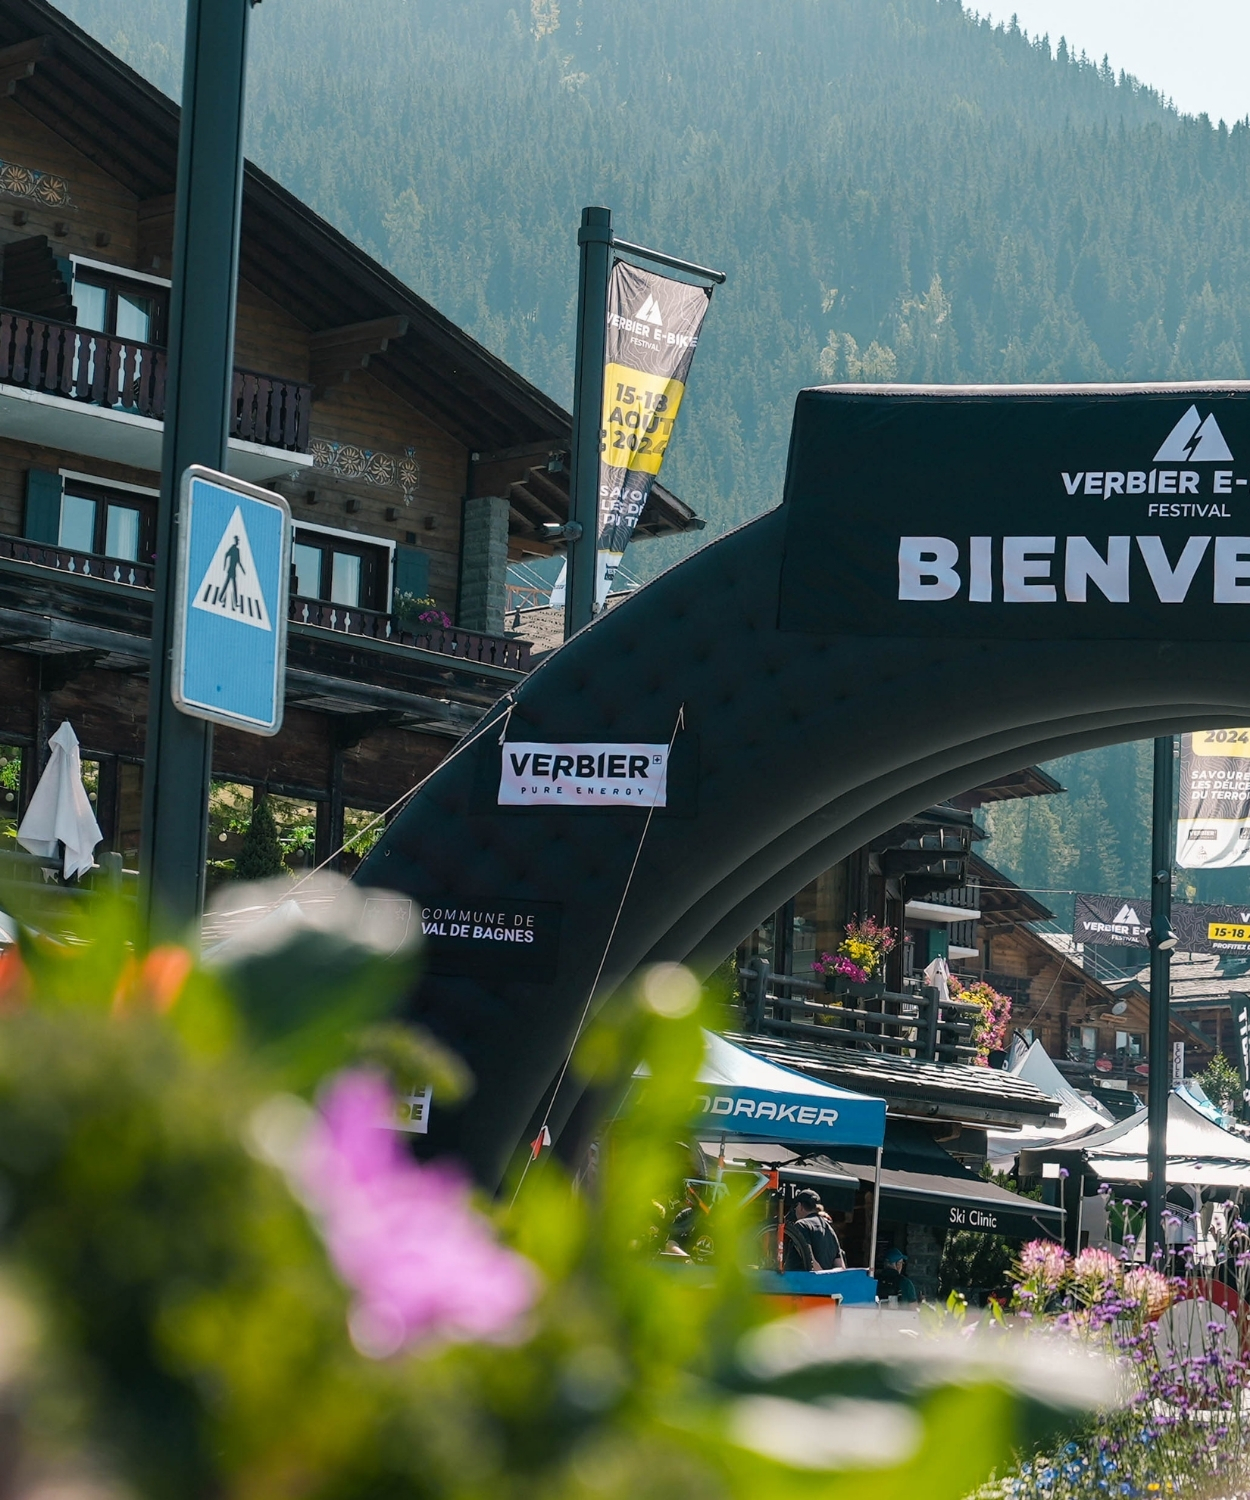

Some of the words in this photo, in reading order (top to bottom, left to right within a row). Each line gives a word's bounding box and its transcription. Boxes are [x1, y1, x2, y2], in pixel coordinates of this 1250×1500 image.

[630, 337, 660, 351] FESTIVAL
[654, 328, 699, 349] E-BIKE
[616, 383, 668, 413] 15-18
[608, 406, 675, 436] AOÛT
[613, 430, 666, 456] 2024
[1061, 469, 1199, 500] VERBIER
[1148, 503, 1231, 517] FESTIVAL
[1204, 730, 1249, 743] 2024
[510, 752, 650, 782] VERBIER
[576, 787, 645, 795] ENERGY
[1191, 780, 1212, 789] LES
[1191, 791, 1208, 799] DU
[421, 908, 506, 925] COMMUNE
[514, 915, 535, 927] DE
[421, 922, 447, 936] VAL
[450, 923, 470, 938] DE
[472, 926, 534, 943] BAGNES
[1083, 921, 1129, 936] VERBIER
[1214, 927, 1245, 939] 15-18
[1111, 934, 1139, 943] FESTIVAL
[1213, 942, 1246, 950] PROFITEZ
[950, 1207, 965, 1224] Ski
[968, 1211, 997, 1228] Clinic
